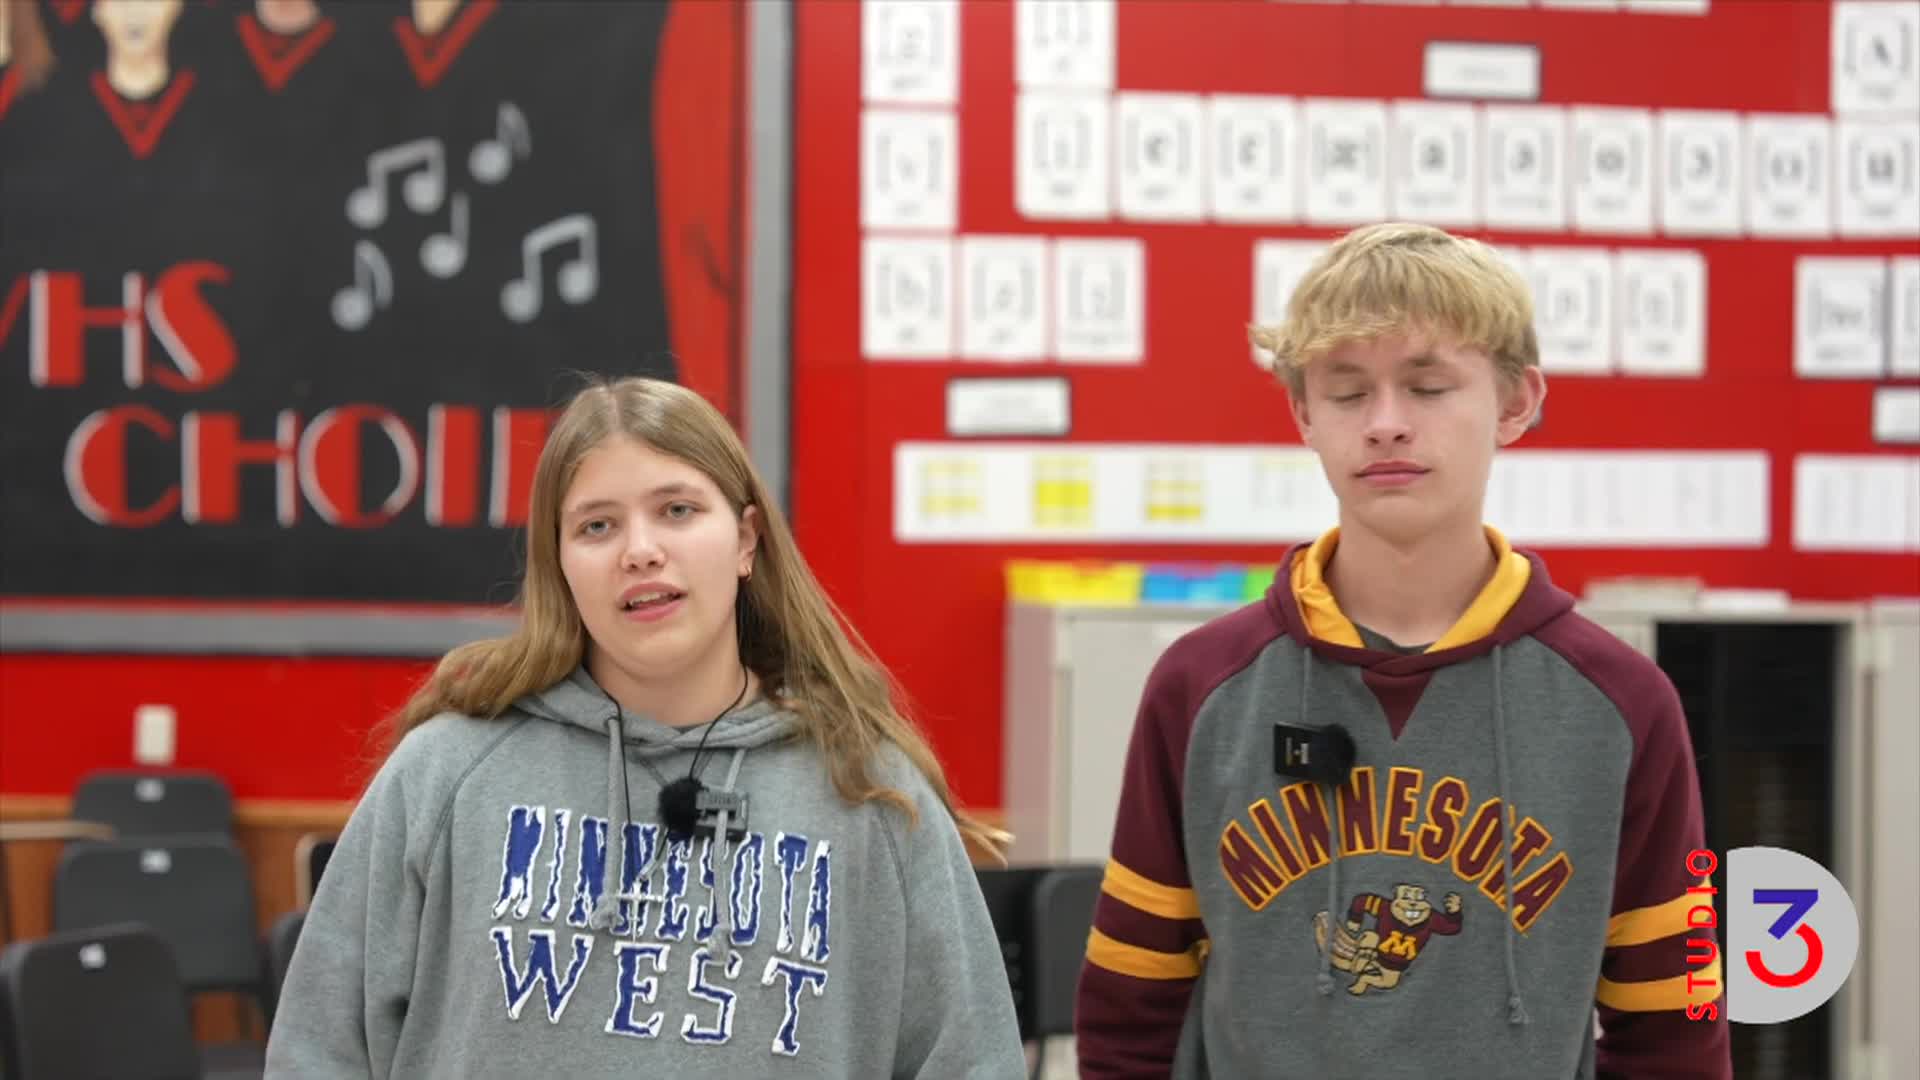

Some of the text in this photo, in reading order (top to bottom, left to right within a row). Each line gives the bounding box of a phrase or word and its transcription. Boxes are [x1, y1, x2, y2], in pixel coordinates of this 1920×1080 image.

[491, 805, 832, 963] MINNESOTA
[1219, 766, 1574, 934] MINNESOTA
[489, 926, 829, 1056] WEST
